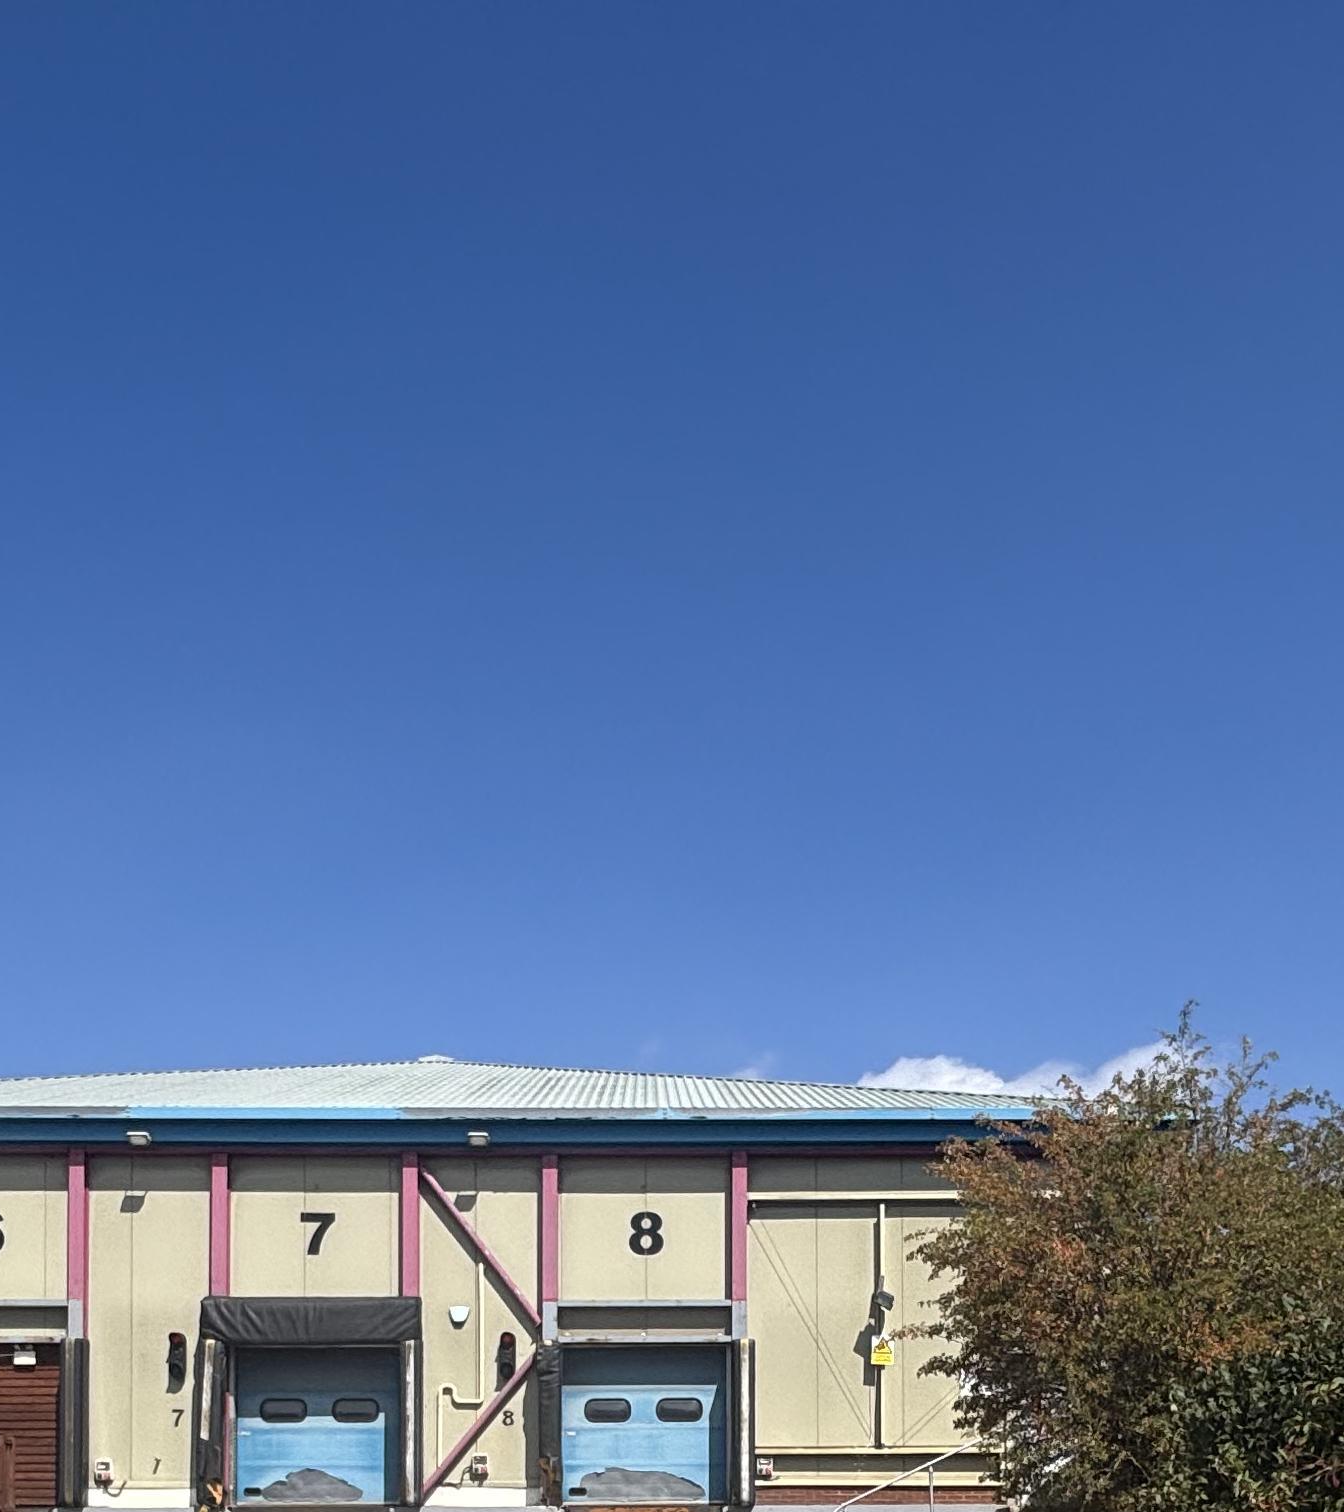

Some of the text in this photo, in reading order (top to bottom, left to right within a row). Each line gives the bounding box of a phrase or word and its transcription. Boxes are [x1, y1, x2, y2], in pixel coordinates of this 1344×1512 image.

[300, 1212, 336, 1256] 7
[628, 1211, 664, 1256] 8
[172, 1409, 185, 1427] 7
[502, 1410, 514, 1426] 8
